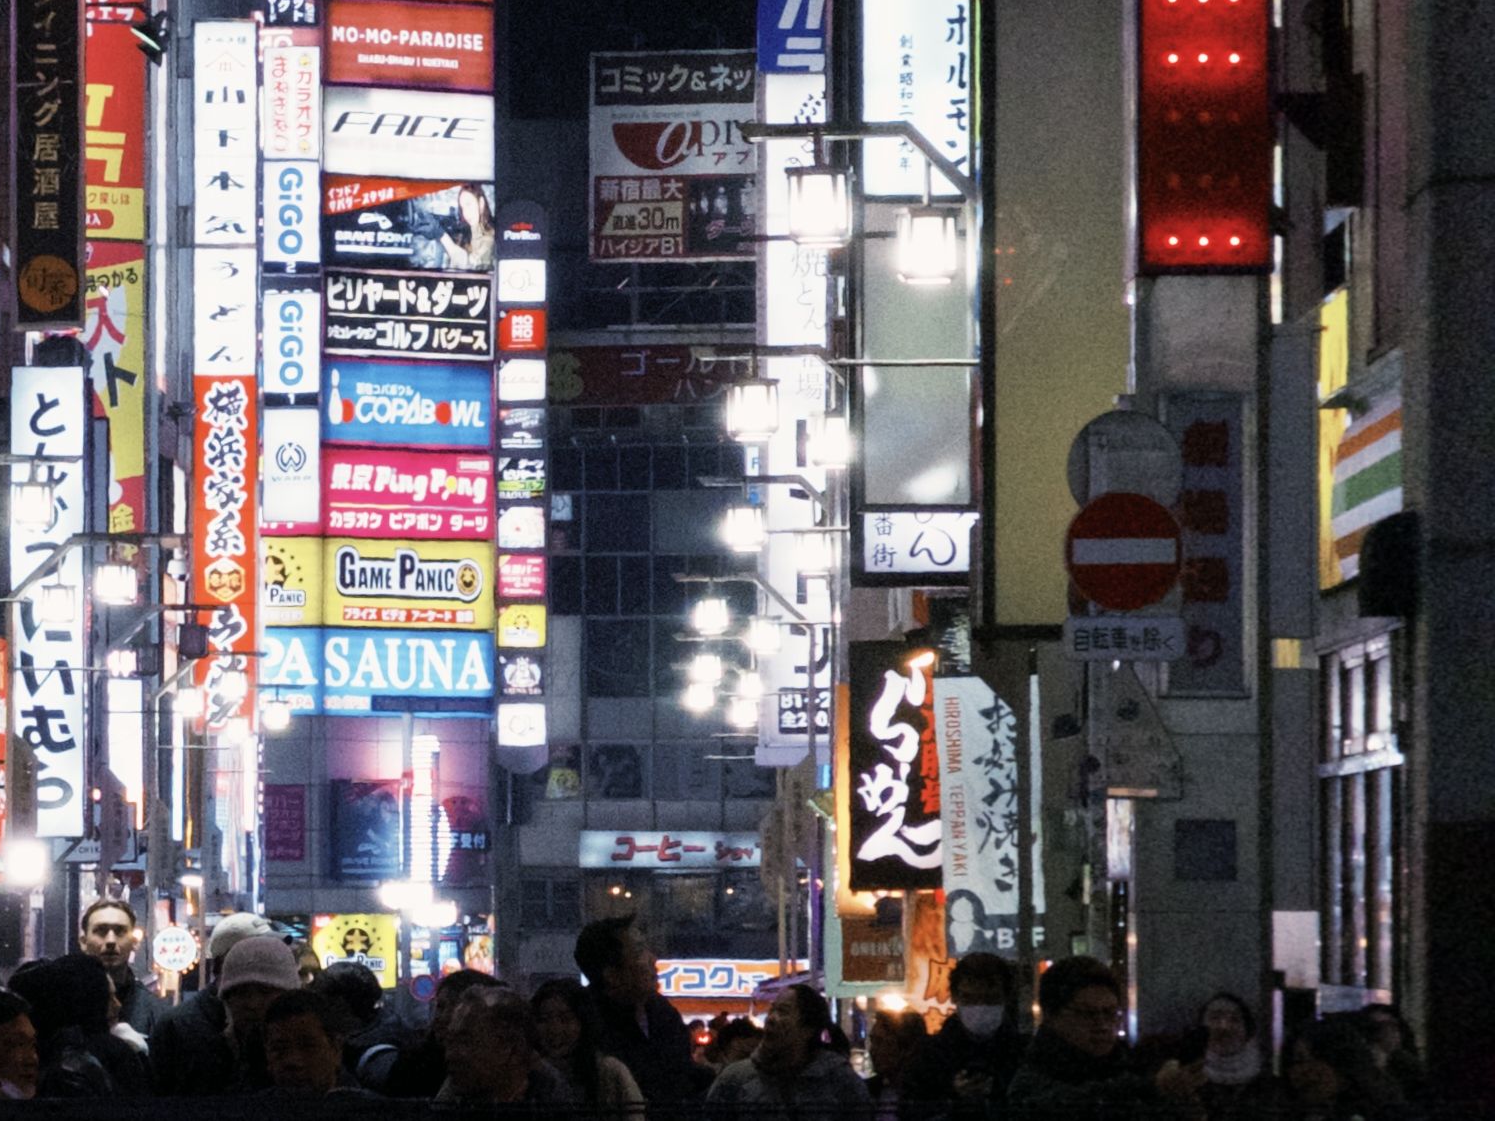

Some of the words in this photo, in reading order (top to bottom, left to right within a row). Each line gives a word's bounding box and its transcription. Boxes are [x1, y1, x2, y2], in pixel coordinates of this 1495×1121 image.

[332, 25, 484, 52] MO-MO-PARADISE
[296, 70, 312, 138] カラオケ
[331, 110, 487, 141] FACE
[278, 167, 303, 256] GiGO
[327, 276, 488, 318] ビリヤード&ダーツ
[279, 299, 304, 386] GiGO
[356, 392, 485, 427] COPABOWL
[339, 550, 392, 590] GAME
[399, 553, 454, 593] PANIC
[1074, 628, 1175, 653] 自転車を除く
[324, 636, 492, 691] SAUNA
[944, 695, 961, 775] HIROSHIMA
[610, 836, 707, 861] コーヒー
[951, 784, 968, 879] TEPPANYAKI
[997, 927, 1045, 950] BF
